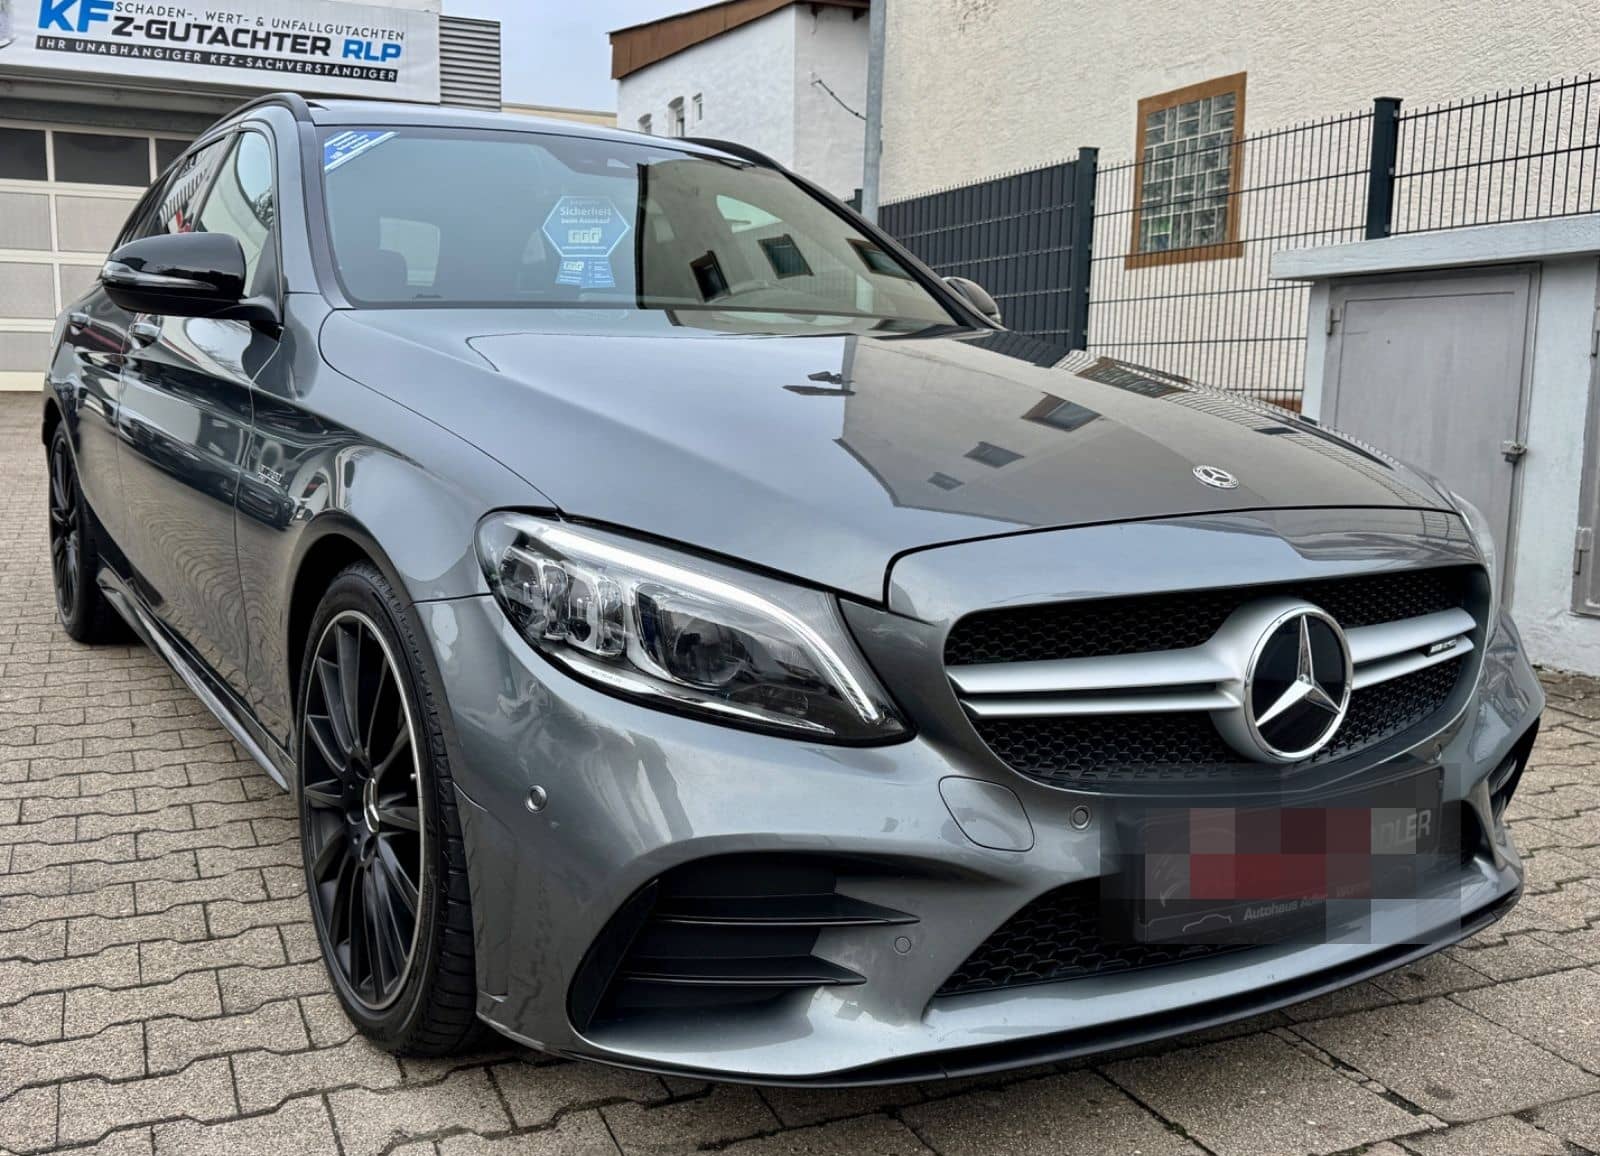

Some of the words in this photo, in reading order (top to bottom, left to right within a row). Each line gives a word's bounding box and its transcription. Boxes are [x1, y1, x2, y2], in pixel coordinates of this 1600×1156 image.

[205, 11, 249, 25] WERT-
[256, 17, 264, 27] &
[271, 18, 404, 41] UNFALLGUTACHTEN
[39, 37, 66, 49] IHR
[342, 39, 401, 62] RLP
[1243, 900, 1298, 921] Autohaus
